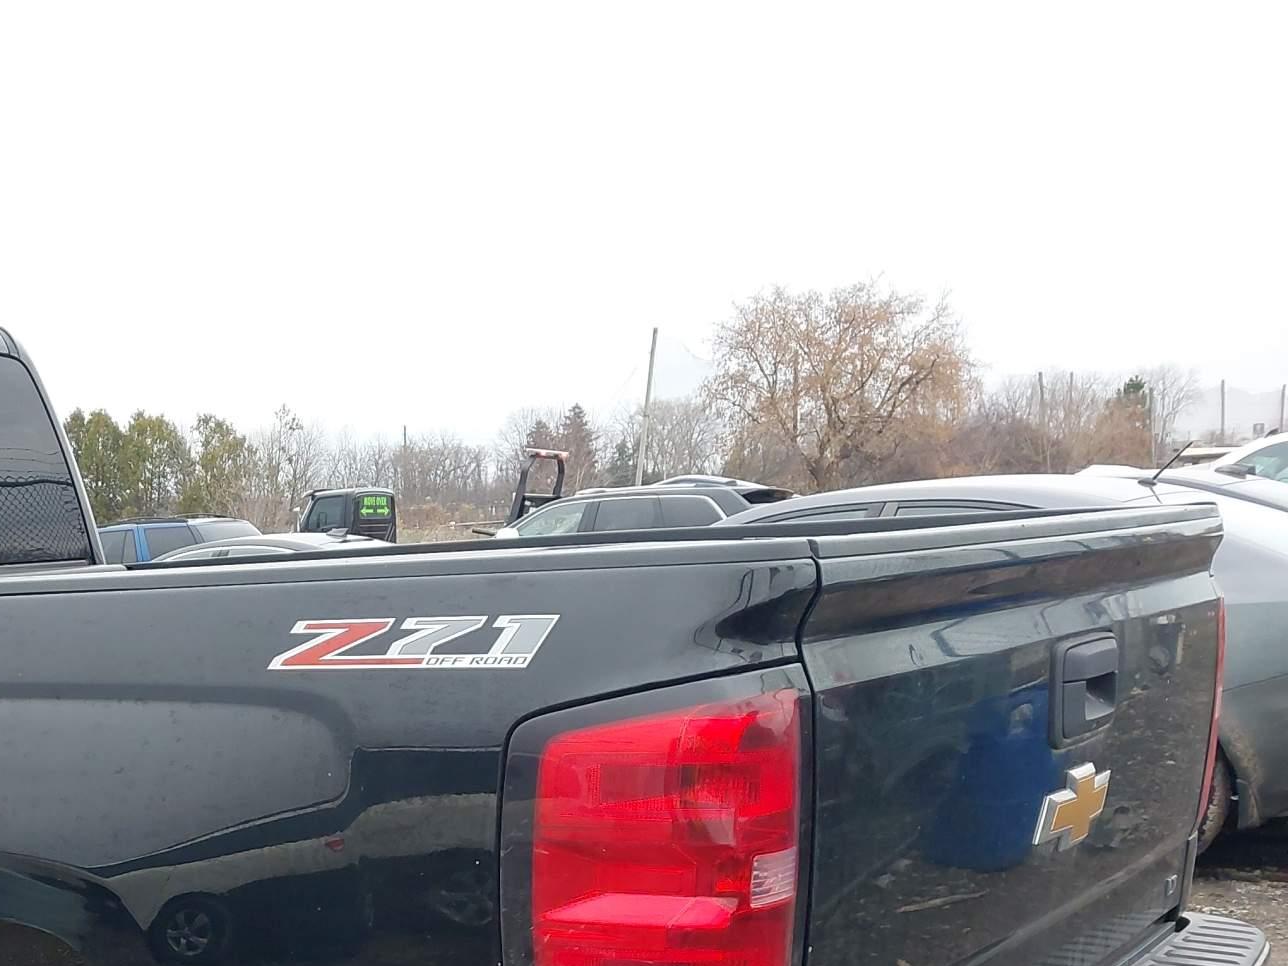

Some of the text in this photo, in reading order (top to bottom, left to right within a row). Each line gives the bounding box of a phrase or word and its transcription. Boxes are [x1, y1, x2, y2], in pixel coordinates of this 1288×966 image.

[267, 614, 561, 670] Z71
[425, 655, 528, 666] OFF ROAD
